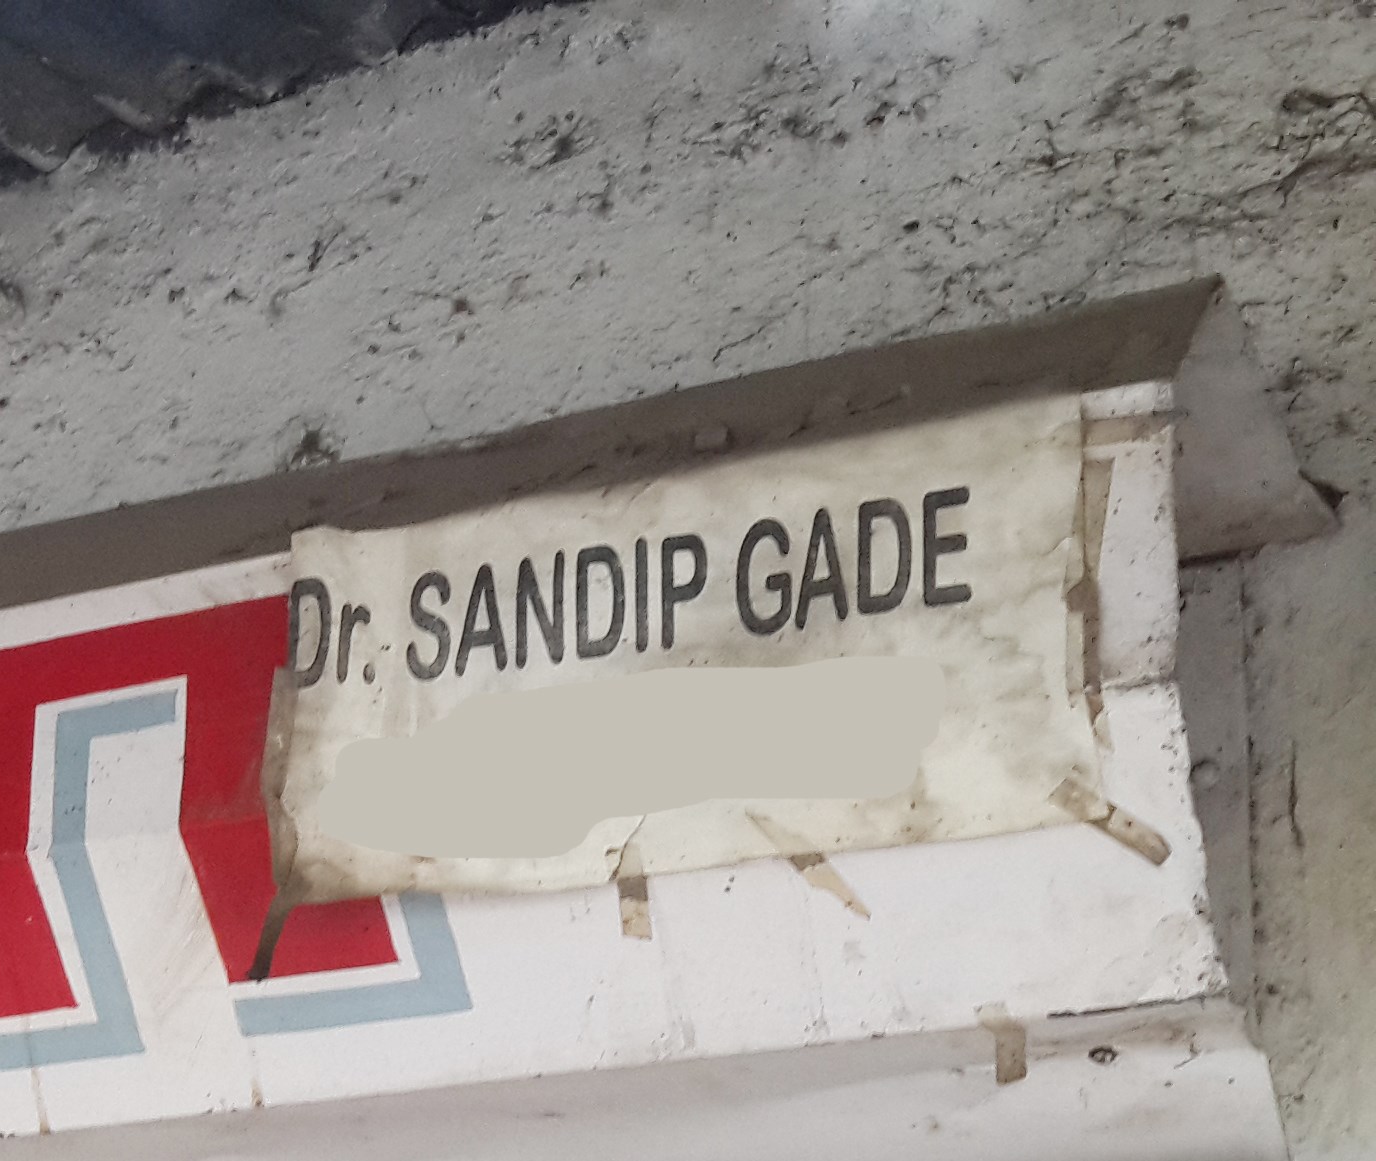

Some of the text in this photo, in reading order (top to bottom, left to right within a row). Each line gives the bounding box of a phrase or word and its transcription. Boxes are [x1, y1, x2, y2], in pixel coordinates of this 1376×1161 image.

[289, 486, 973, 689] Dr. SANDIP GADE
